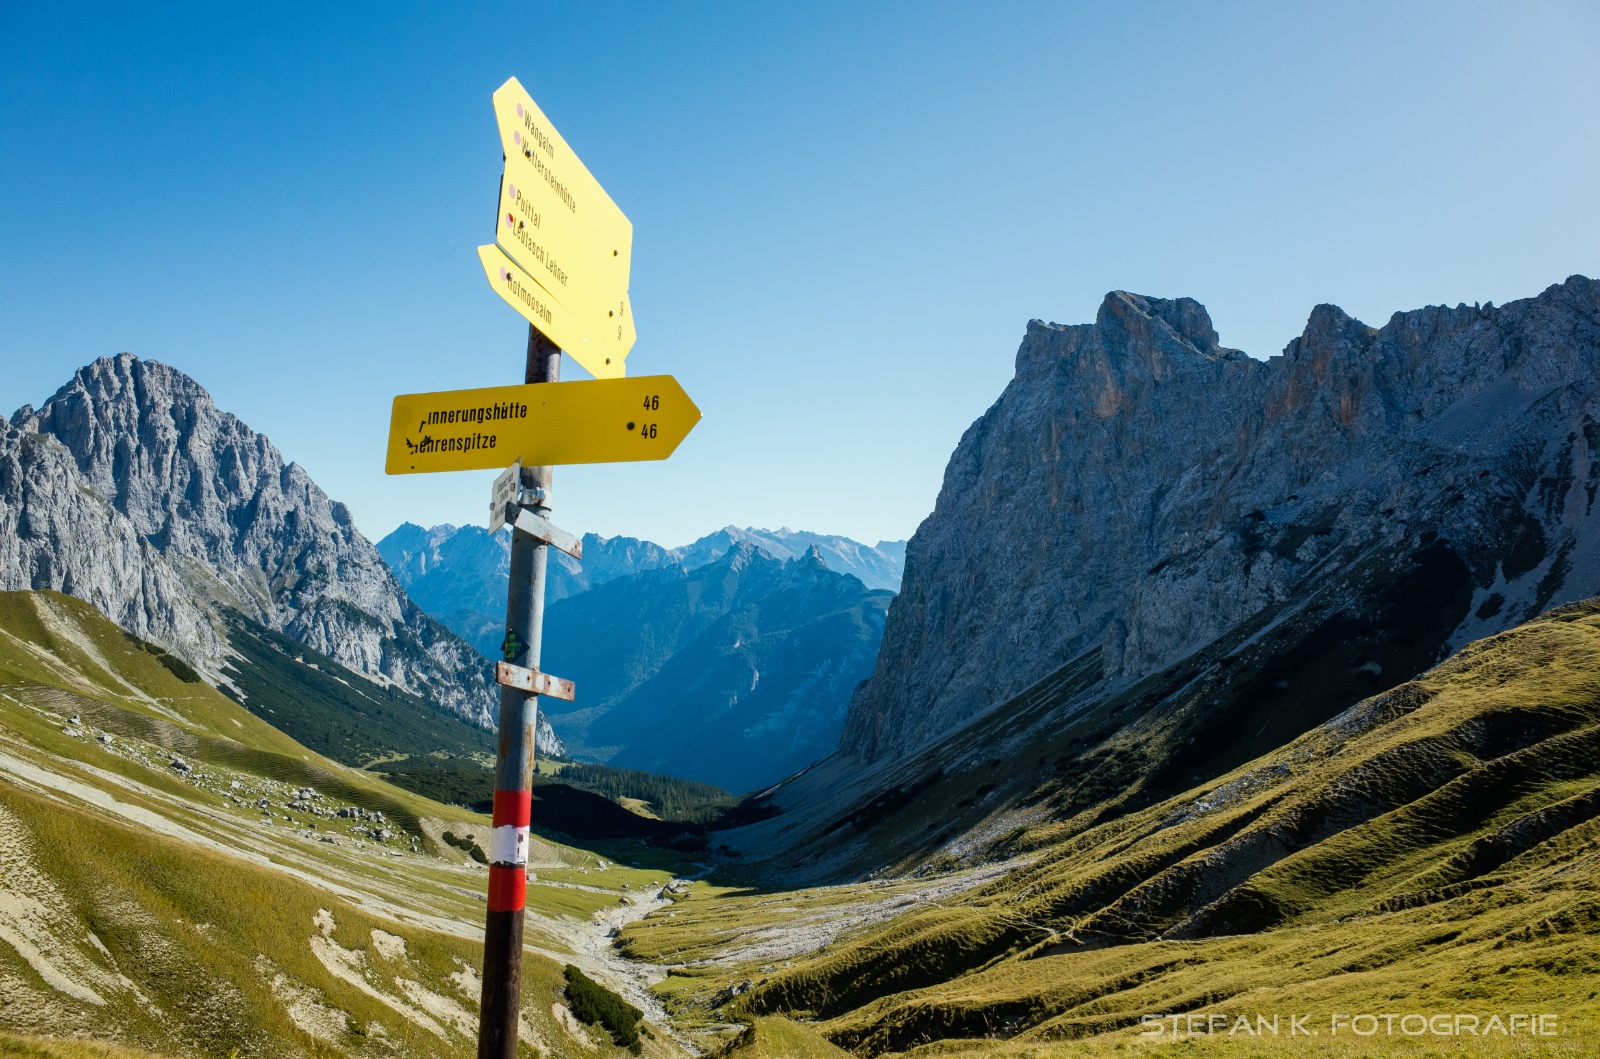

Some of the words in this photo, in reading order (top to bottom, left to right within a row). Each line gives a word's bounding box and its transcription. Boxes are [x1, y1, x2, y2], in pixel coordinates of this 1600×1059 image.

[524, 109, 554, 159] Wangalm
[522, 136, 576, 214] Wttersteinhütte
[516, 189, 541, 230] Puittal
[513, 217, 545, 264] Leutasch
[546, 252, 568, 287] Lehner
[643, 395, 659, 411] 46
[641, 423, 657, 439] 46
